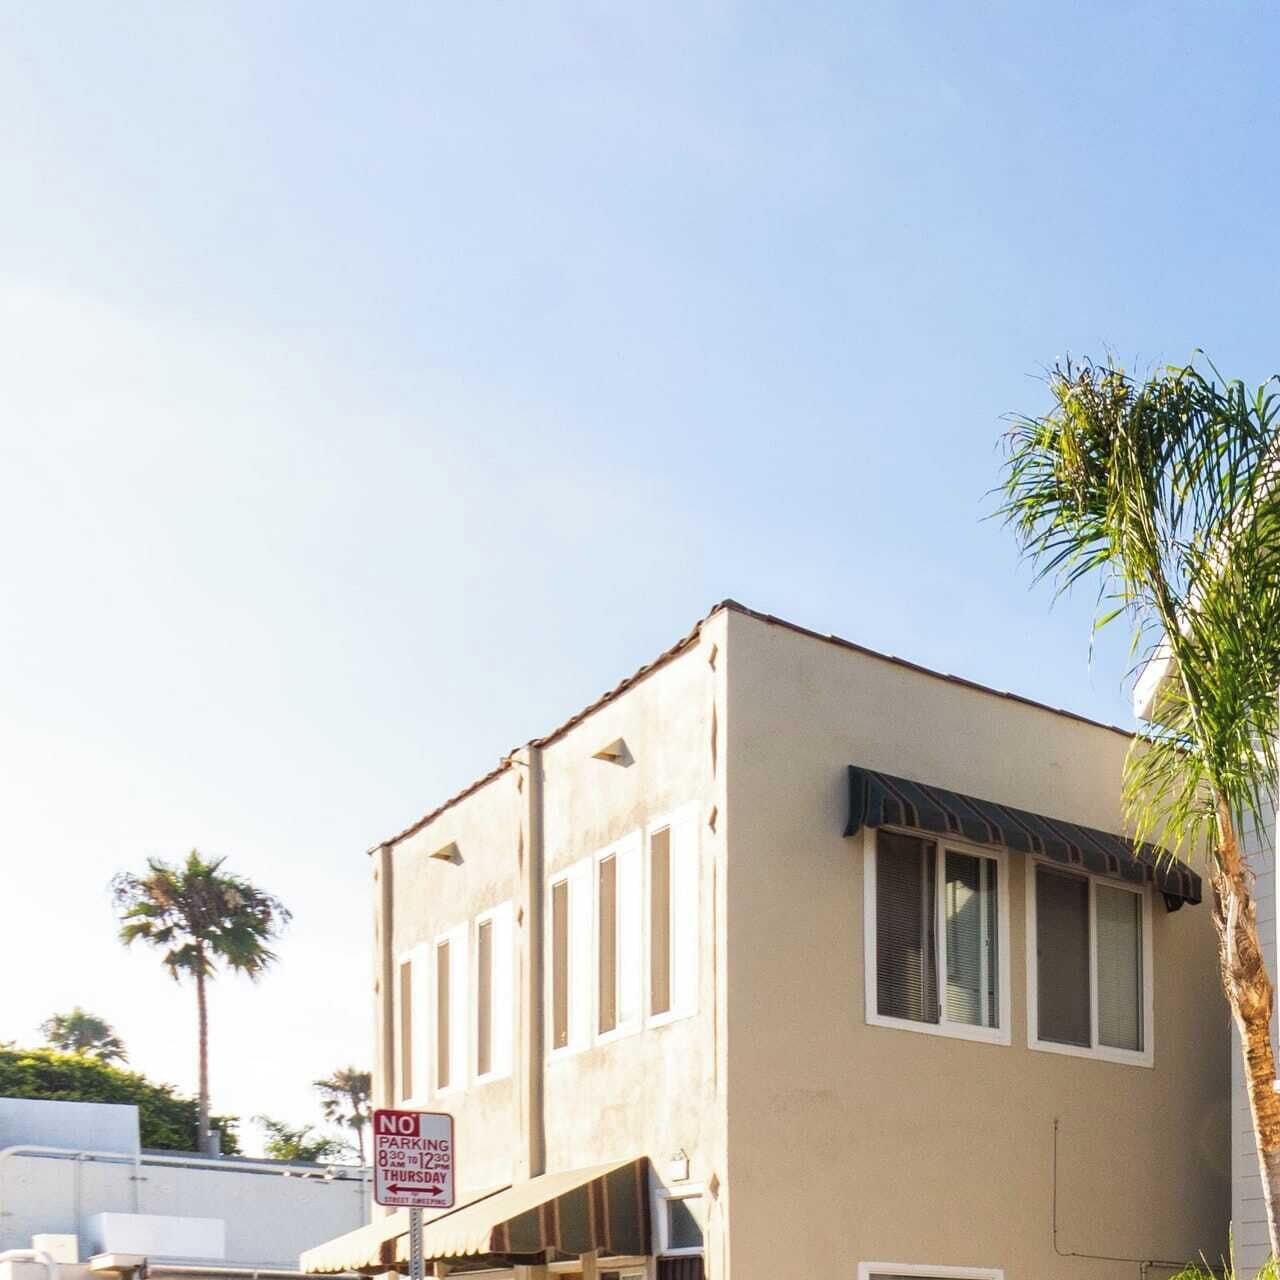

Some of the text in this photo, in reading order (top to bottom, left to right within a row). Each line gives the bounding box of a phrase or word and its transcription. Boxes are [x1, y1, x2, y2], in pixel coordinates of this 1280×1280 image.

[380, 1114, 416, 1134] NO
[379, 1137, 449, 1151] PARKING
[408, 1156, 417, 1164] TO
[382, 1169, 447, 1184] THURSDAY
